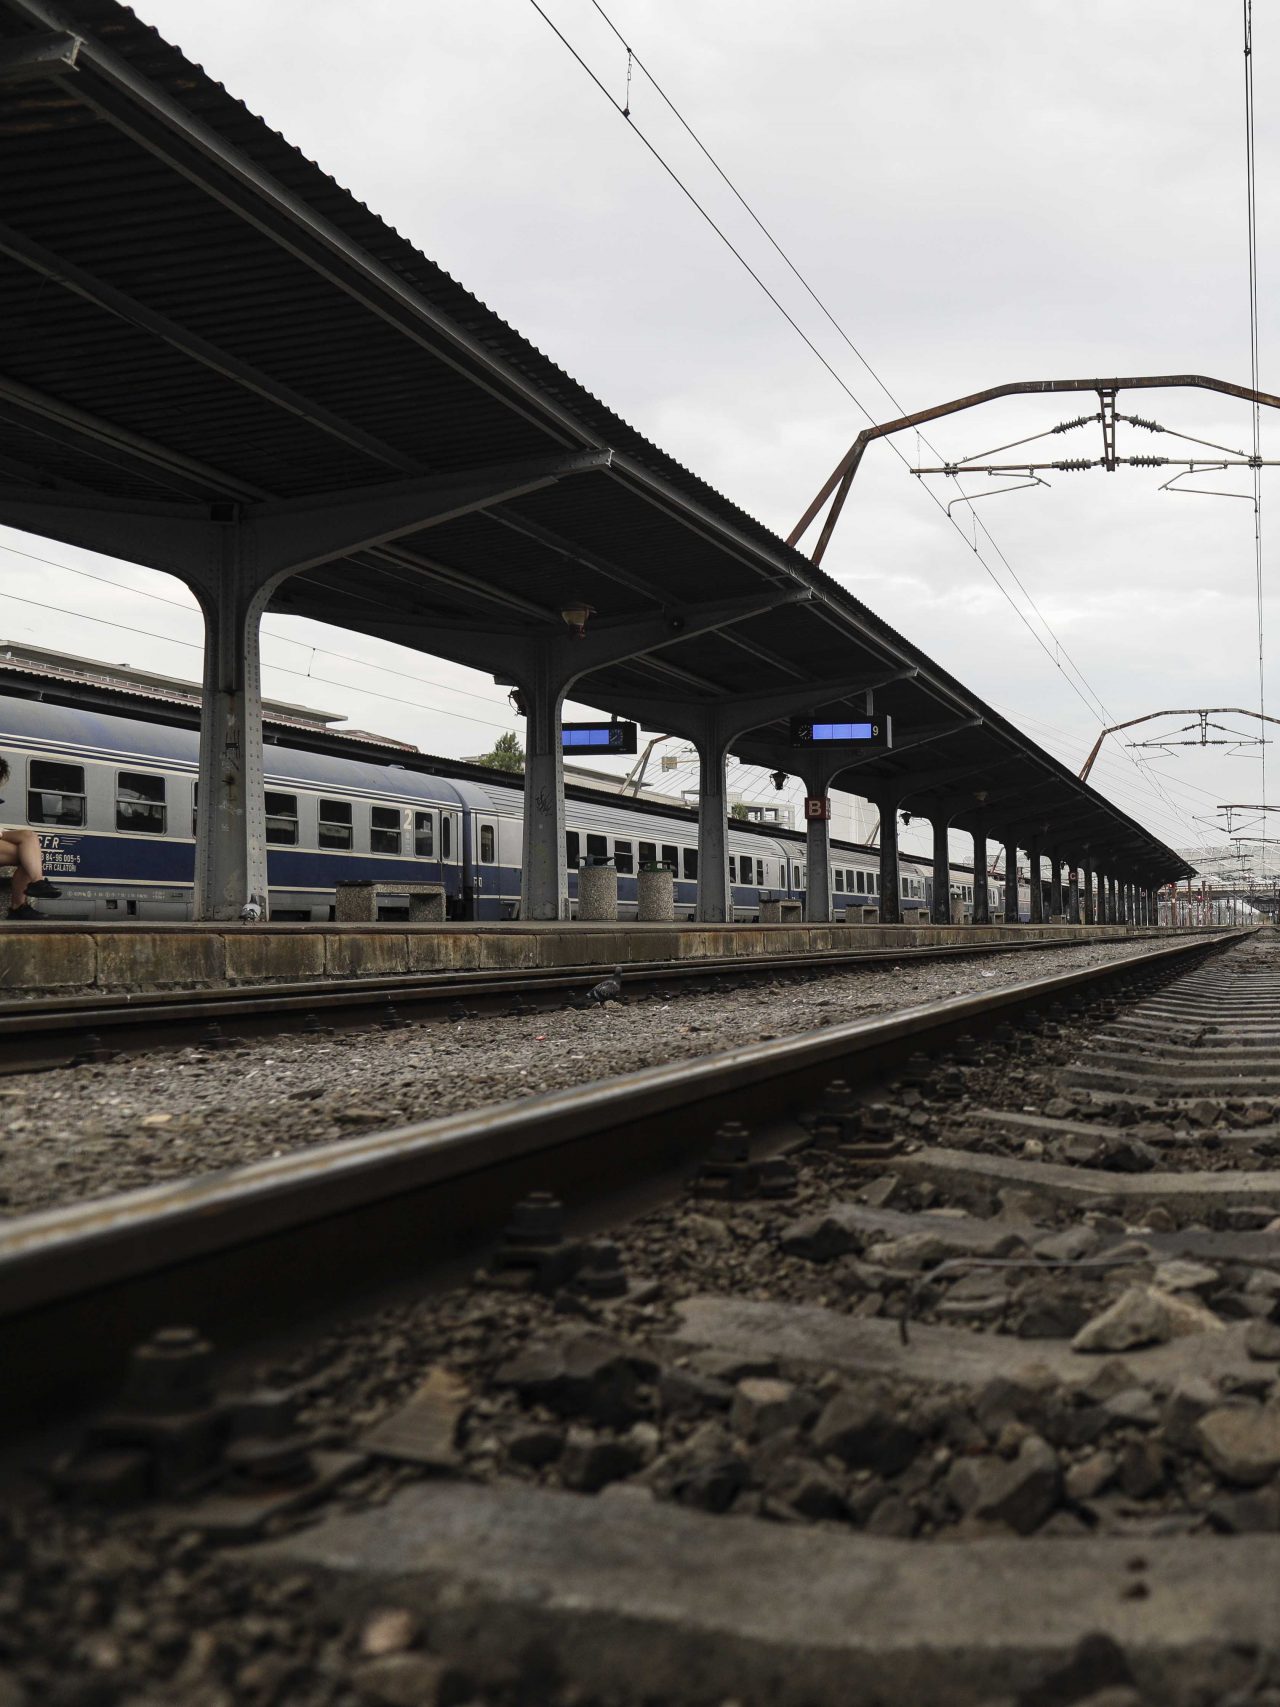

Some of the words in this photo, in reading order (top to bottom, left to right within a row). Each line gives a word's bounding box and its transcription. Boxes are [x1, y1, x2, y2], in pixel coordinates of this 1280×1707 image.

[872, 725, 879, 736] 9
[808, 800, 822, 816] B
[403, 808, 412, 830] 2
[1070, 872, 1076, 880] C
